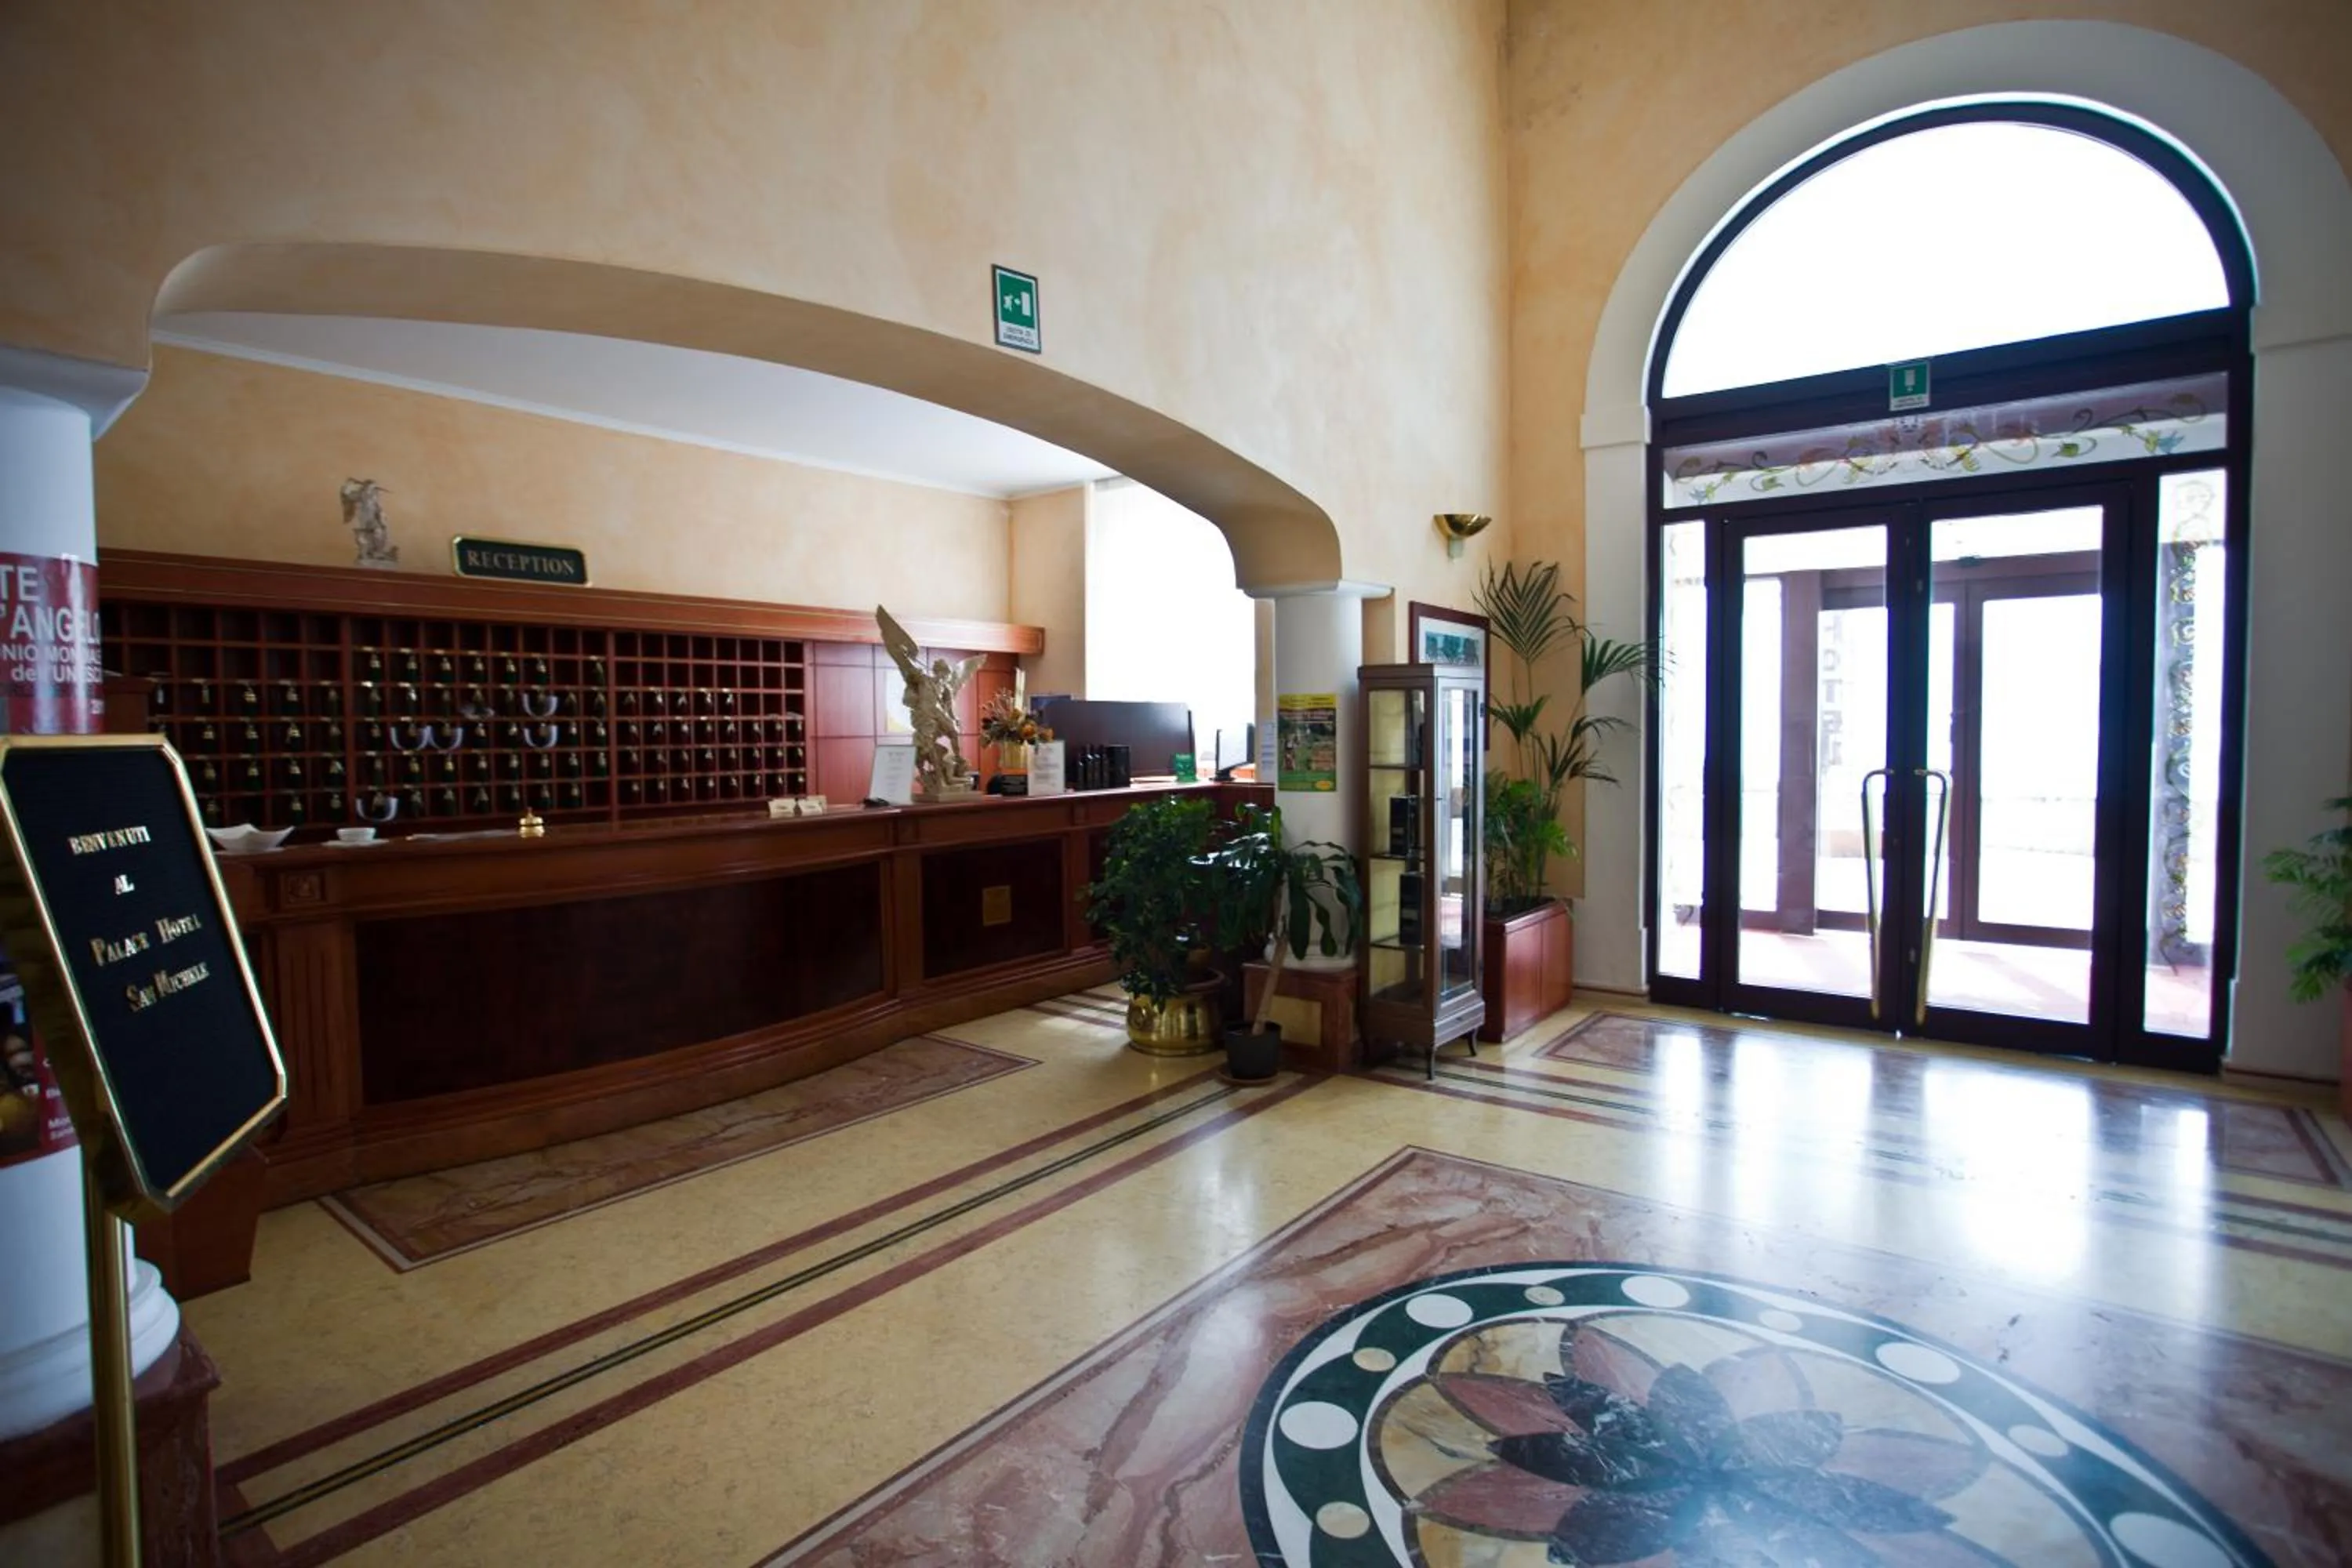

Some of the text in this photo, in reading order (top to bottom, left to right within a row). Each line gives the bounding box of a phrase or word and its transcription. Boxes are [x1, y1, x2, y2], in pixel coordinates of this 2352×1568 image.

[466, 550, 575, 575] RECEPTION
[0, 643, 37, 662] NIO
[67, 826, 151, 855] BENVENUTI
[114, 874, 135, 895] AL
[155, 913, 202, 943] HOTEL
